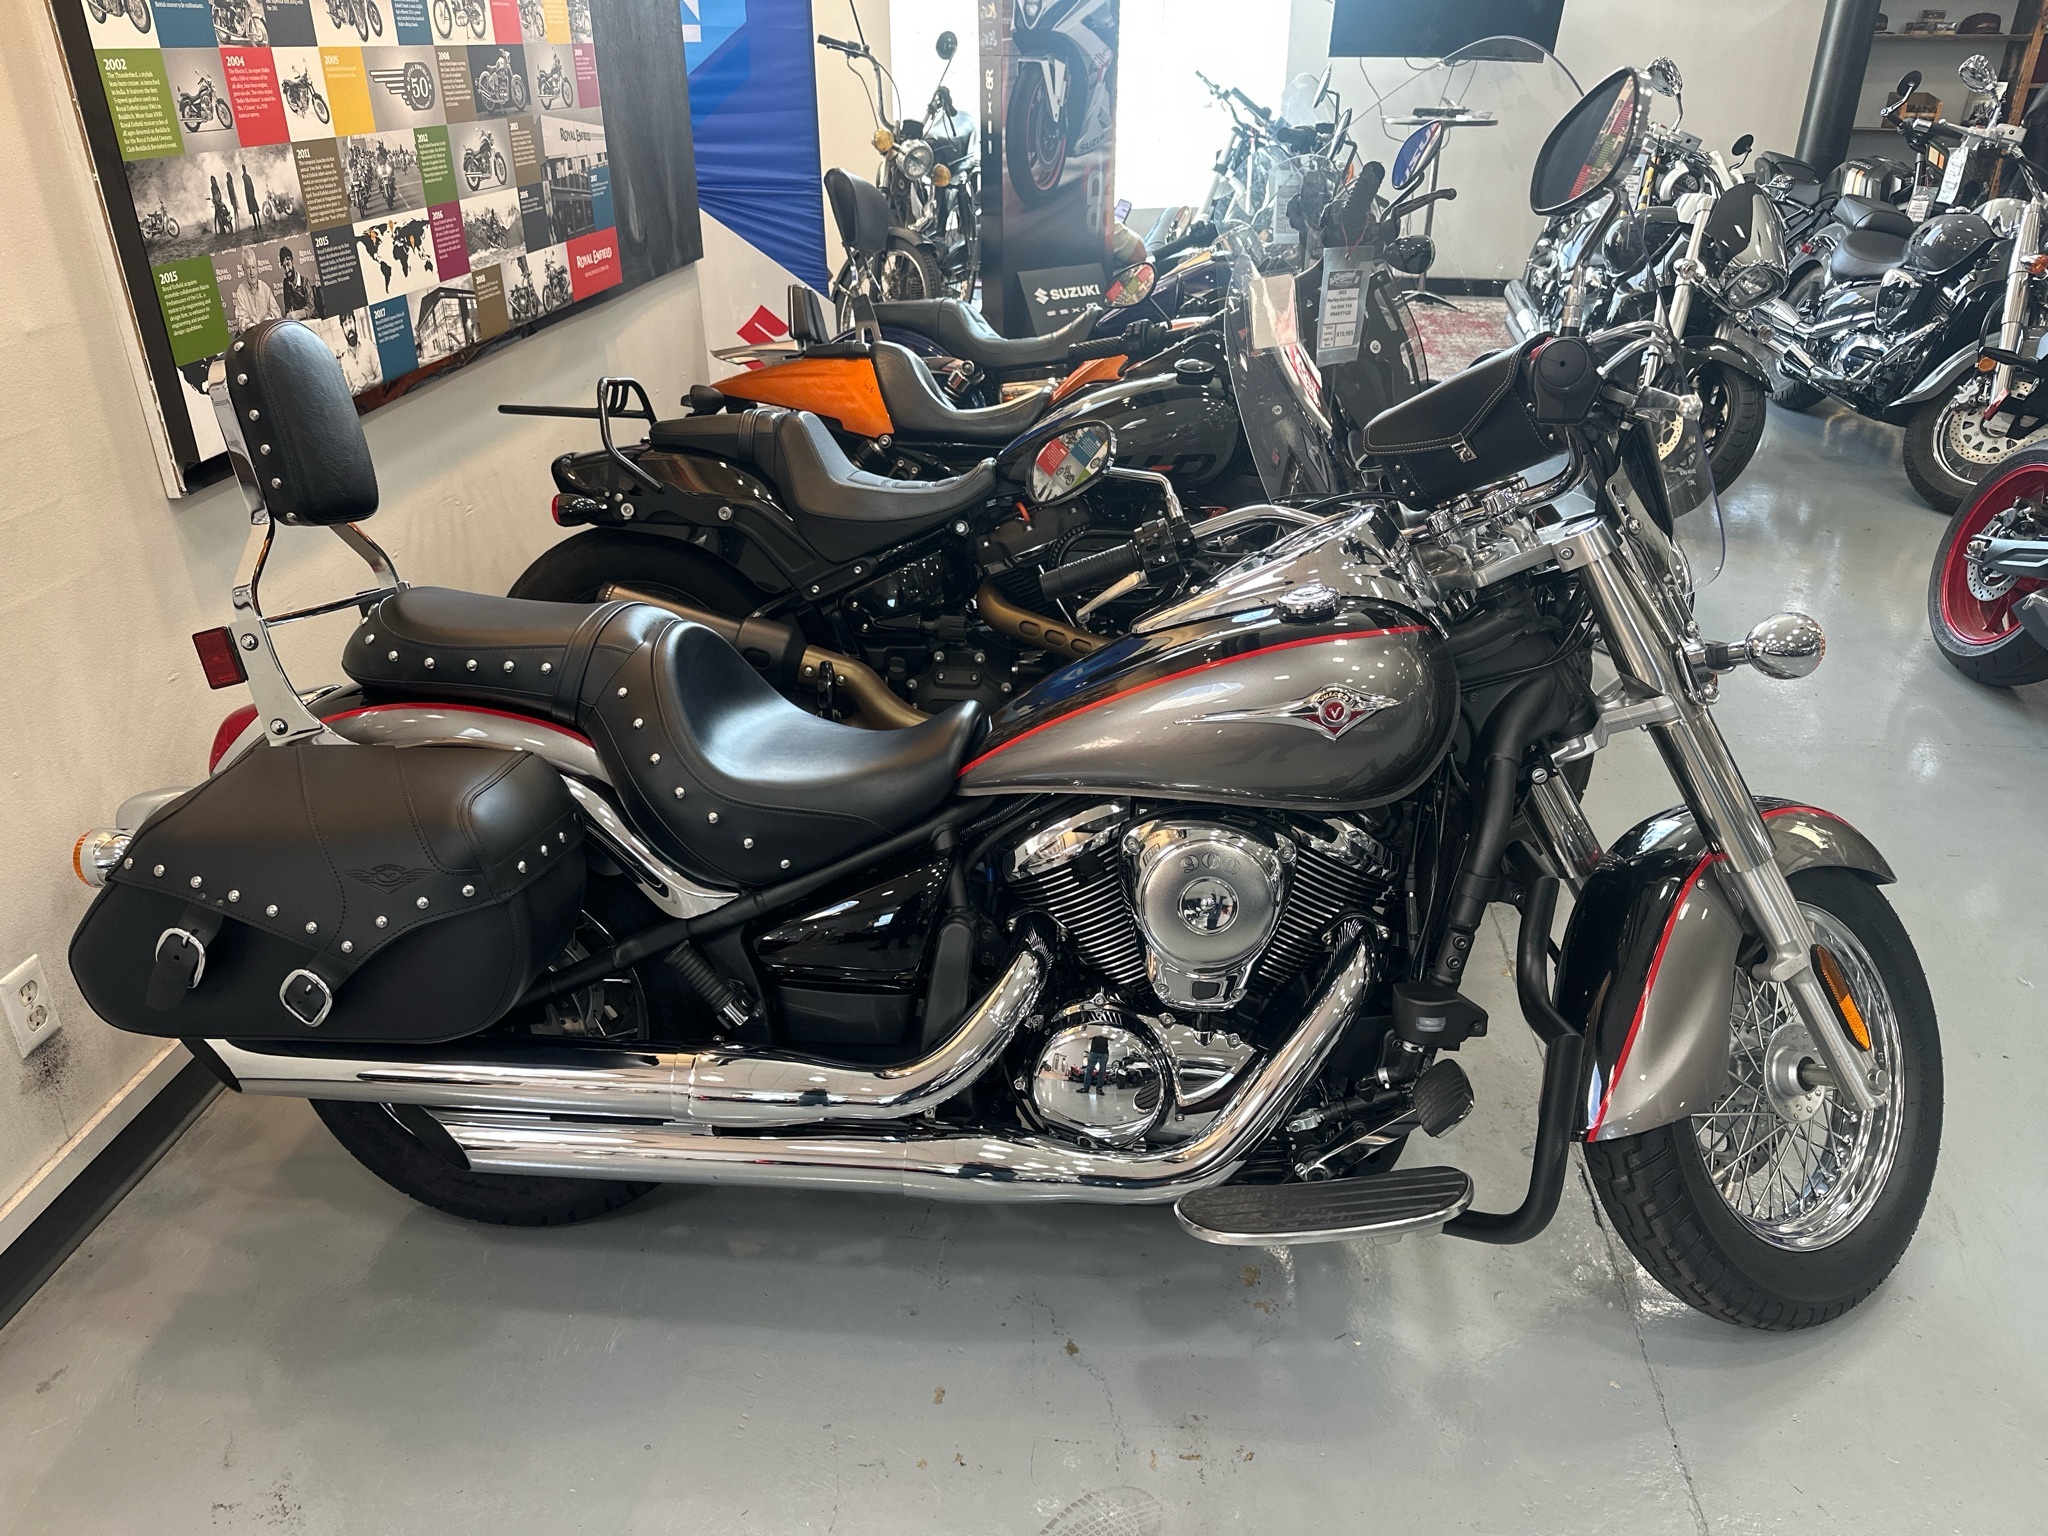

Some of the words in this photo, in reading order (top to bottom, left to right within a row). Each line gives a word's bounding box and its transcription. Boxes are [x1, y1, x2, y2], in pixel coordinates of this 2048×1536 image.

[103, 59, 127, 70] 2002
[226, 56, 245, 66] 2004
[324, 56, 339, 64] 2005
[411, 77, 428, 98] 50
[560, 128, 576, 142] ROYAL
[576, 130, 591, 142] ENFIELD
[296, 149, 311, 159] 2011
[315, 236, 329, 247] 2015
[299, 255, 314, 264] ENFIELD
[576, 254, 593, 268] ROYAL
[592, 247, 612, 264] ENFIELD
[258, 264, 272, 273] ENFIELD
[159, 271, 178, 284] 2015
[216, 274, 232, 282] ENFIELD
[1050, 284, 1100, 300] SUZUKI
[374, 308, 385, 319] 2017
[1329, 707, 1341, 719] V
[1180, 852, 1241, 875] 900
